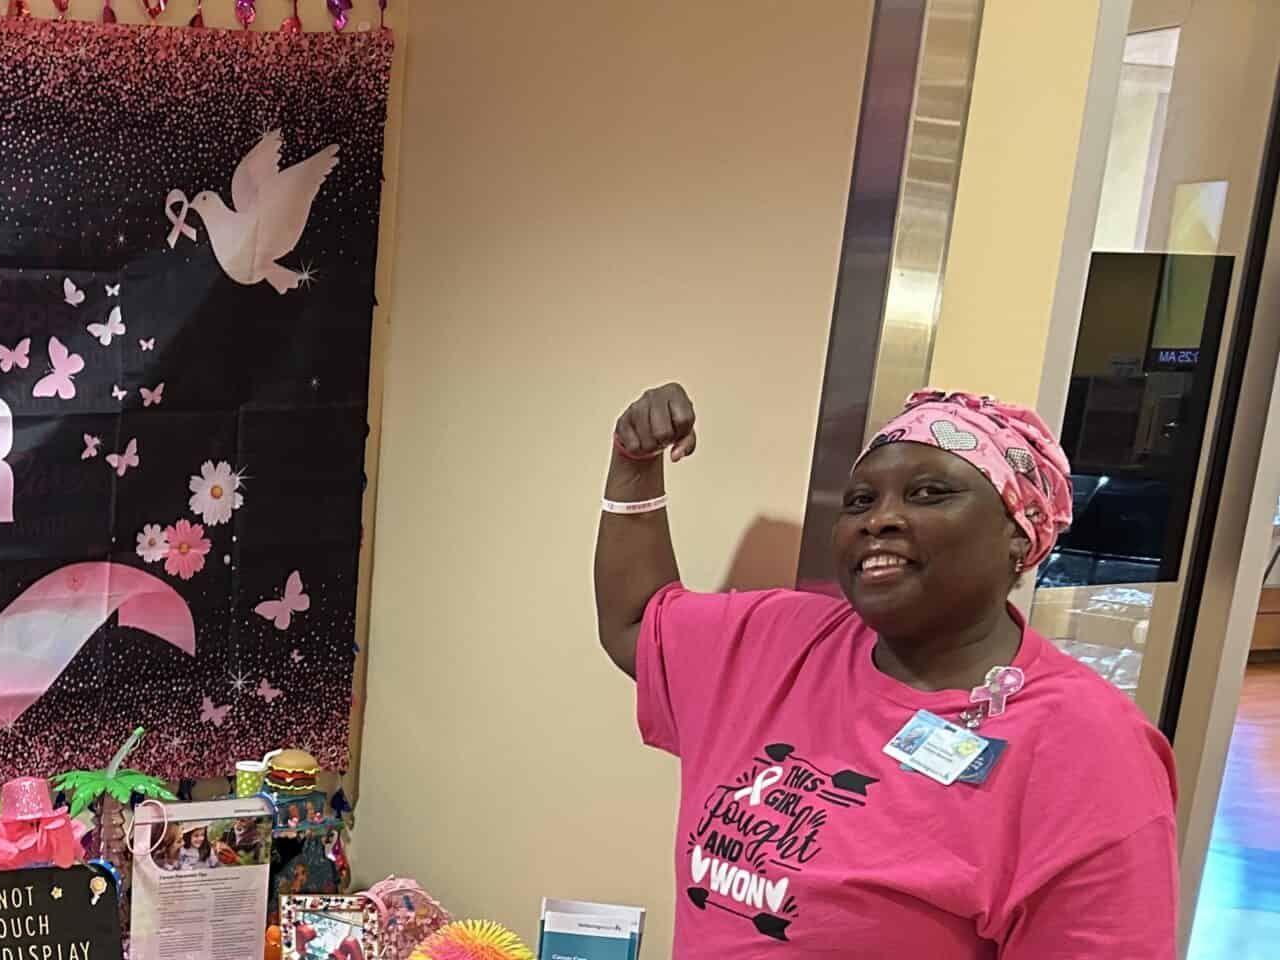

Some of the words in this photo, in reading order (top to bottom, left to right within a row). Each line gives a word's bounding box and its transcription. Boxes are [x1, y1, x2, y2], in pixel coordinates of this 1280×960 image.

[783, 765, 826, 792] THIS
[764, 789, 803, 817] GIRL
[704, 831, 744, 863] AND
[710, 857, 766, 909] WON
